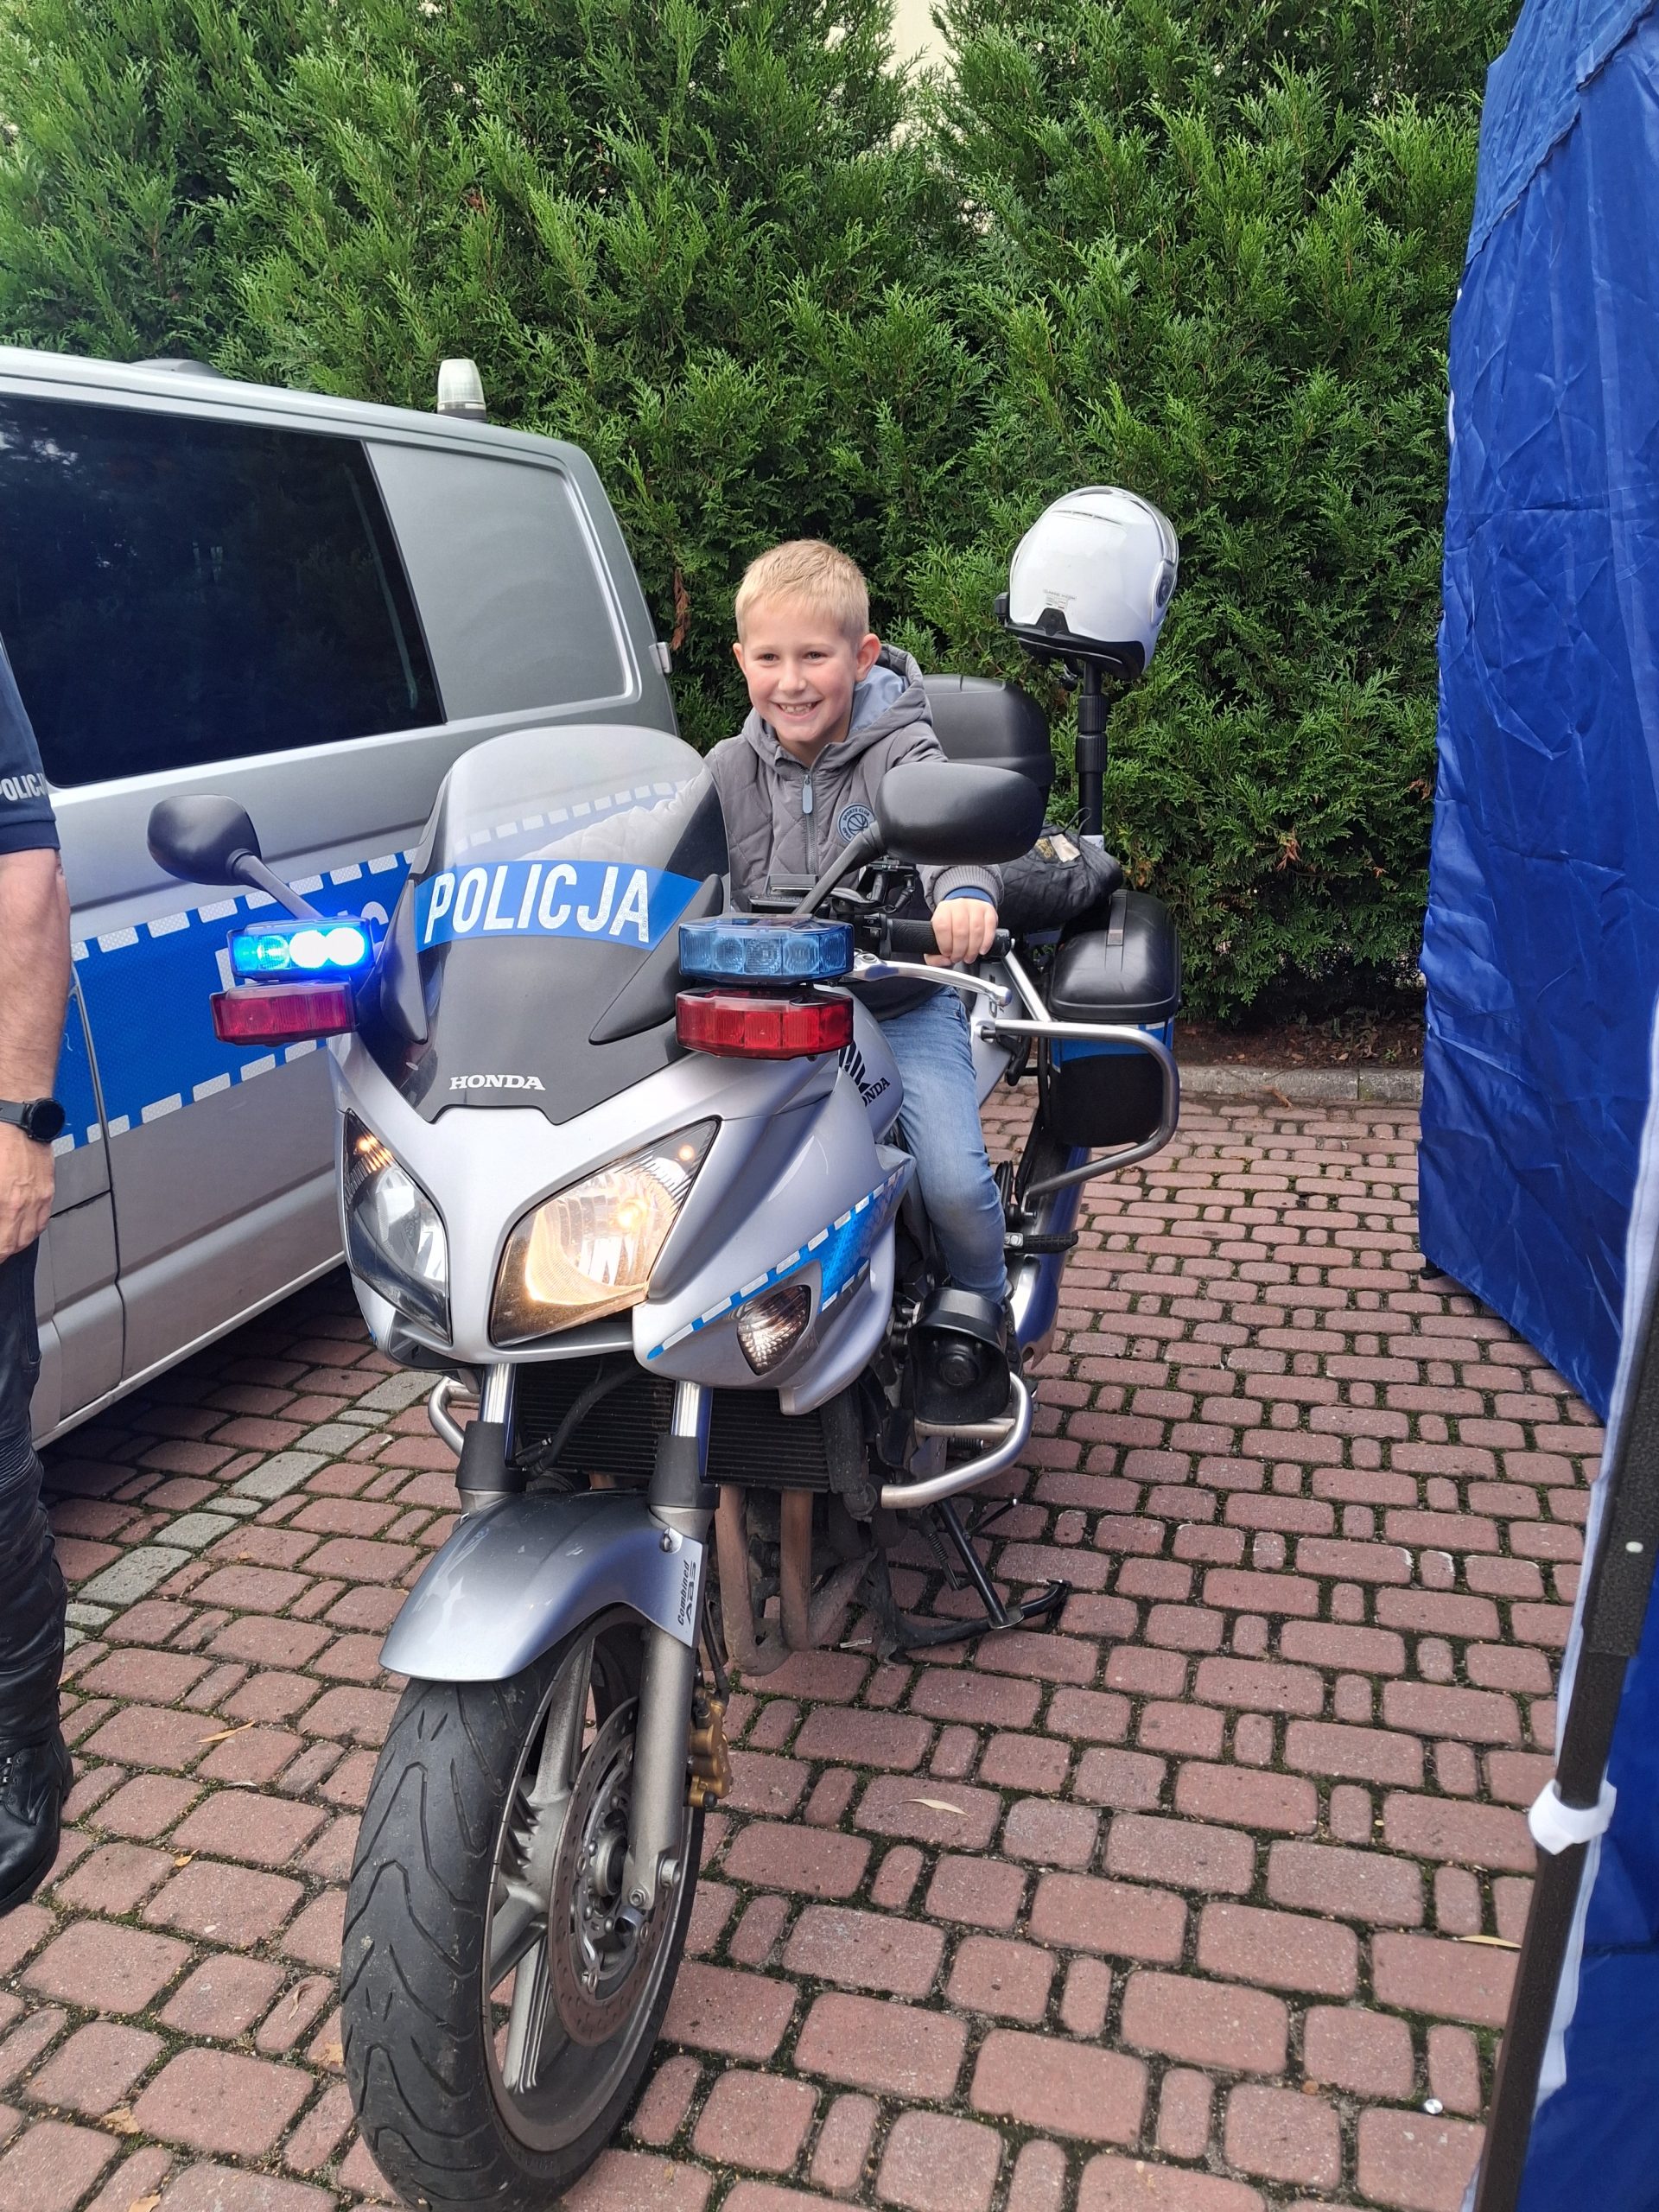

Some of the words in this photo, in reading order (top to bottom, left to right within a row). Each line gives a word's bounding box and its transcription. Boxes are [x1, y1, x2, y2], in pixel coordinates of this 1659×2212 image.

[0, 772, 47, 801] OLICJ
[423, 863, 649, 944] POLICJA
[449, 1074, 546, 1090] HONDA
[677, 1559, 690, 1626] Combined
[686, 1560, 696, 1625] ABS
